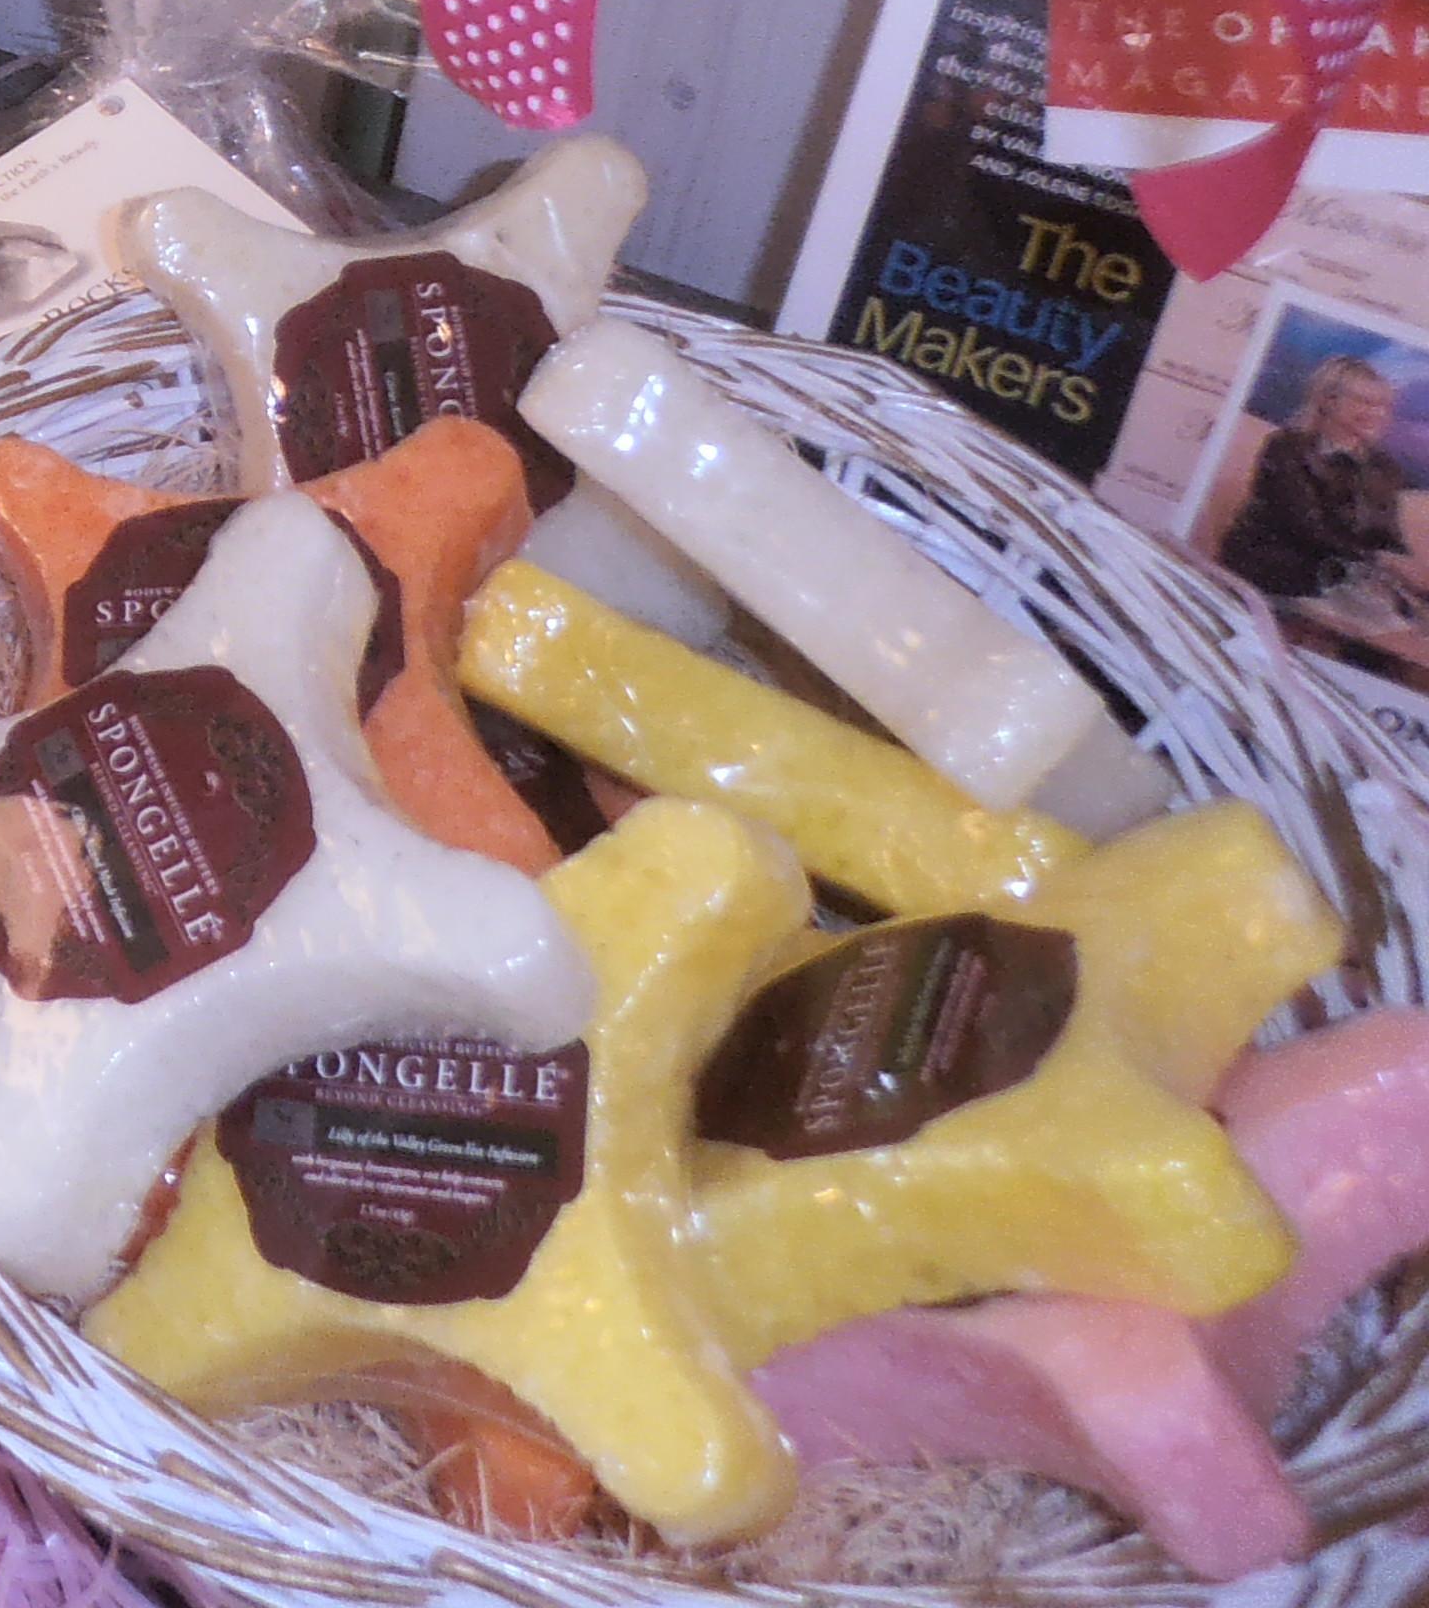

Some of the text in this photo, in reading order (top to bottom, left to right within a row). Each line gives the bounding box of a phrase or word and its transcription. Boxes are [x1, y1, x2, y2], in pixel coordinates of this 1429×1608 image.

[1067, 60, 1429, 116] MAGAZNE
[1018, 214, 1141, 303] The
[878, 239, 1126, 373] Beauty
[851, 297, 1100, 425] Makers
[286, 1034, 560, 1102] ONGELLÉ
